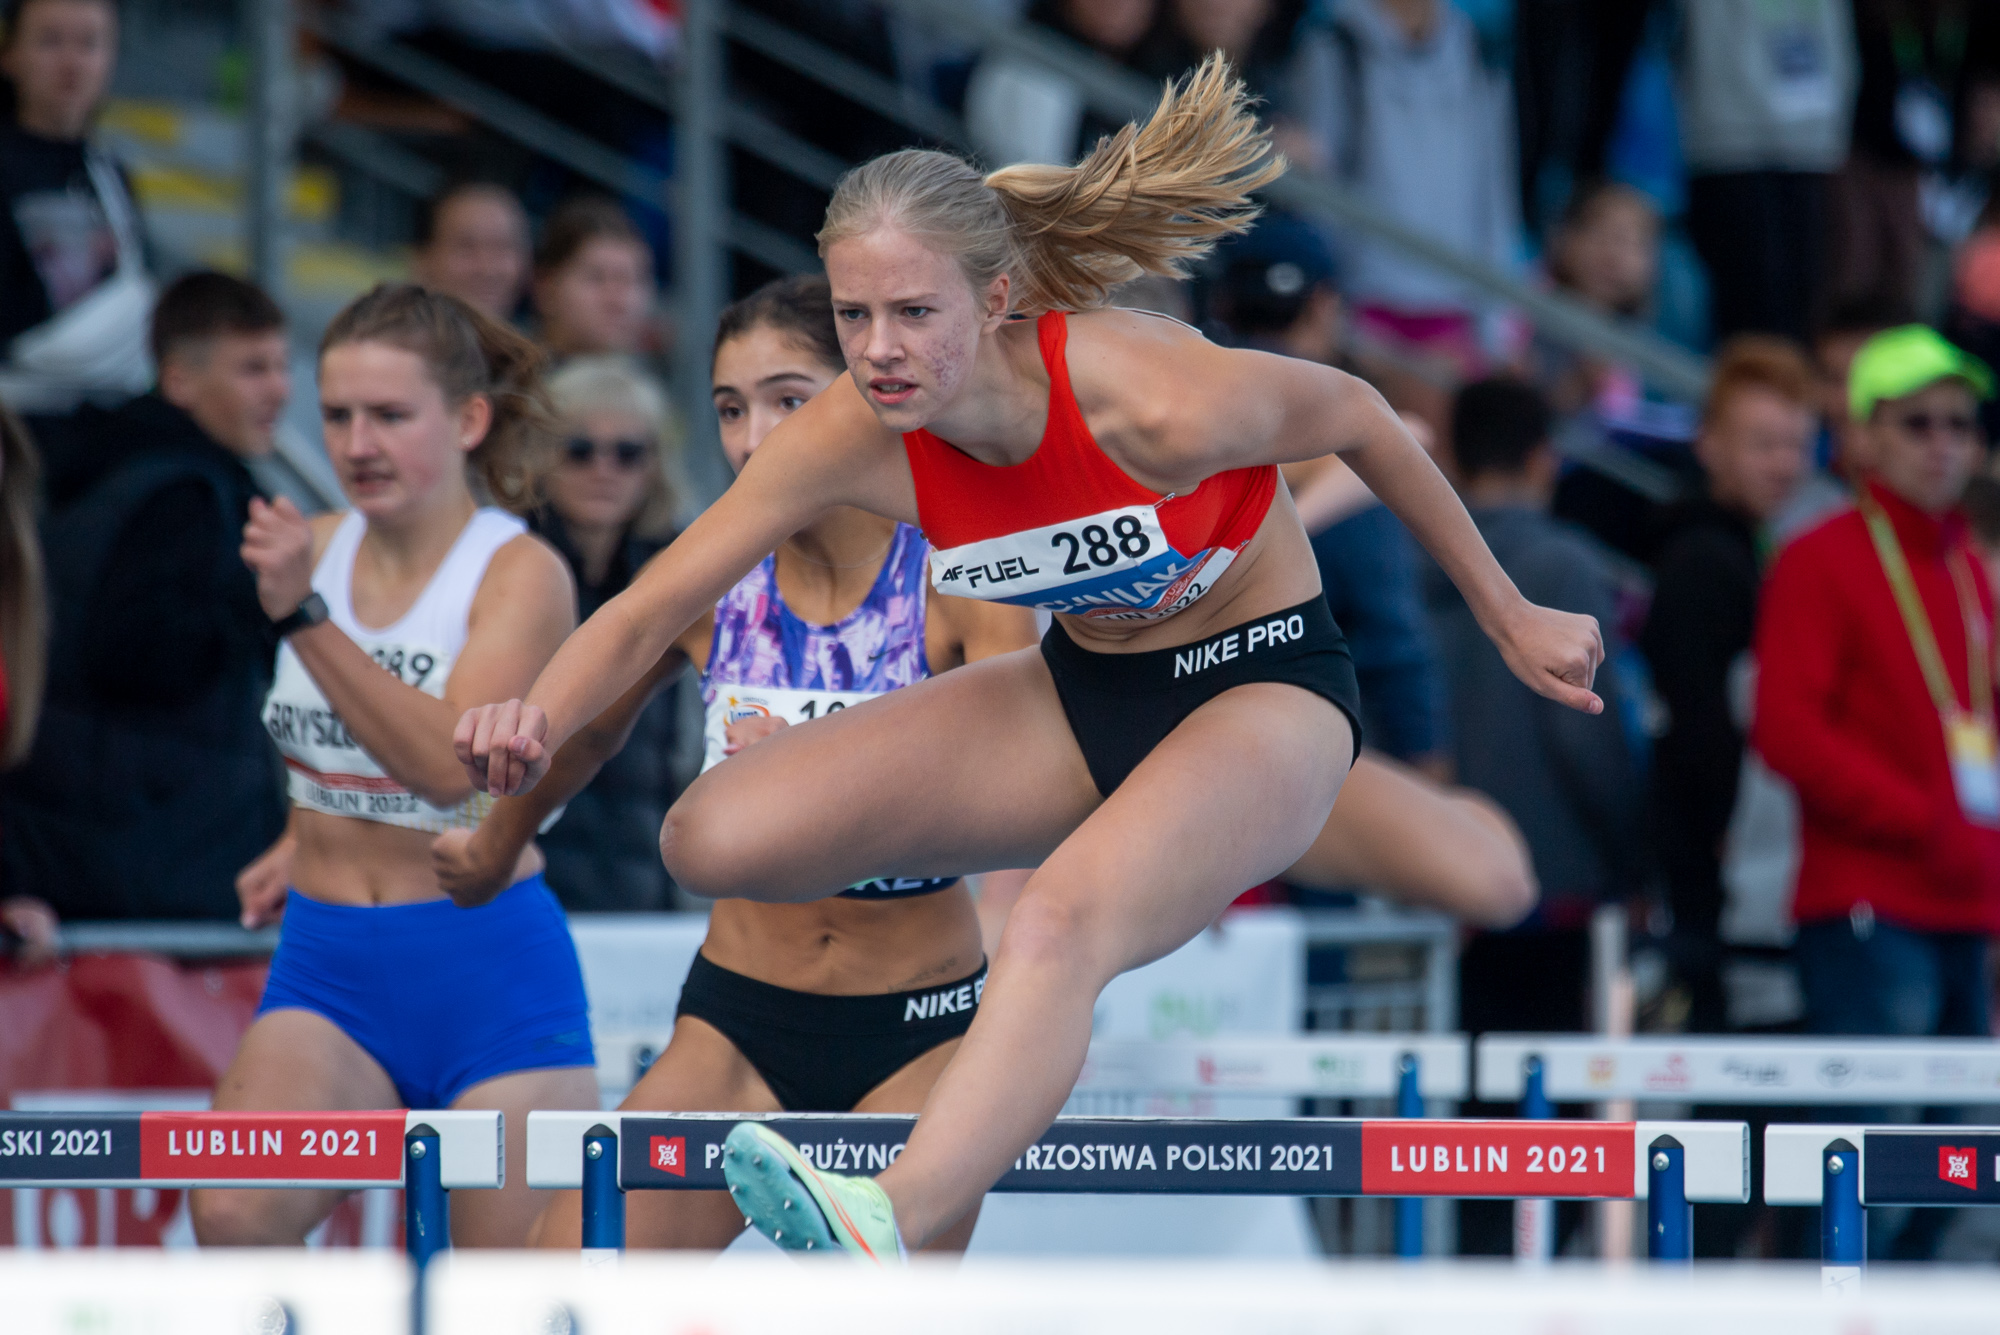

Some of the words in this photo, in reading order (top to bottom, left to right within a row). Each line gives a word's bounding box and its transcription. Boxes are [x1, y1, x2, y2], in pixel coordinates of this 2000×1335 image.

[1051, 514, 1151, 576] 288
[965, 556, 1040, 588] FUEL
[1174, 633, 1240, 679] NIKE
[1247, 614, 1304, 653] PRO
[903, 983, 973, 1022] NIKE
[973, 971, 989, 1004] P
[0, 1129, 42, 1156] SKI
[50, 1129, 112, 1156] 2021
[168, 1129, 283, 1156] LUBLIN
[299, 1129, 377, 1157] 2021
[1166, 1144, 1262, 1171] POLSKI
[1269, 1144, 1333, 1171] 2021
[1391, 1145, 1508, 1172] LUBLIN
[1526, 1145, 1604, 1173] 2021
